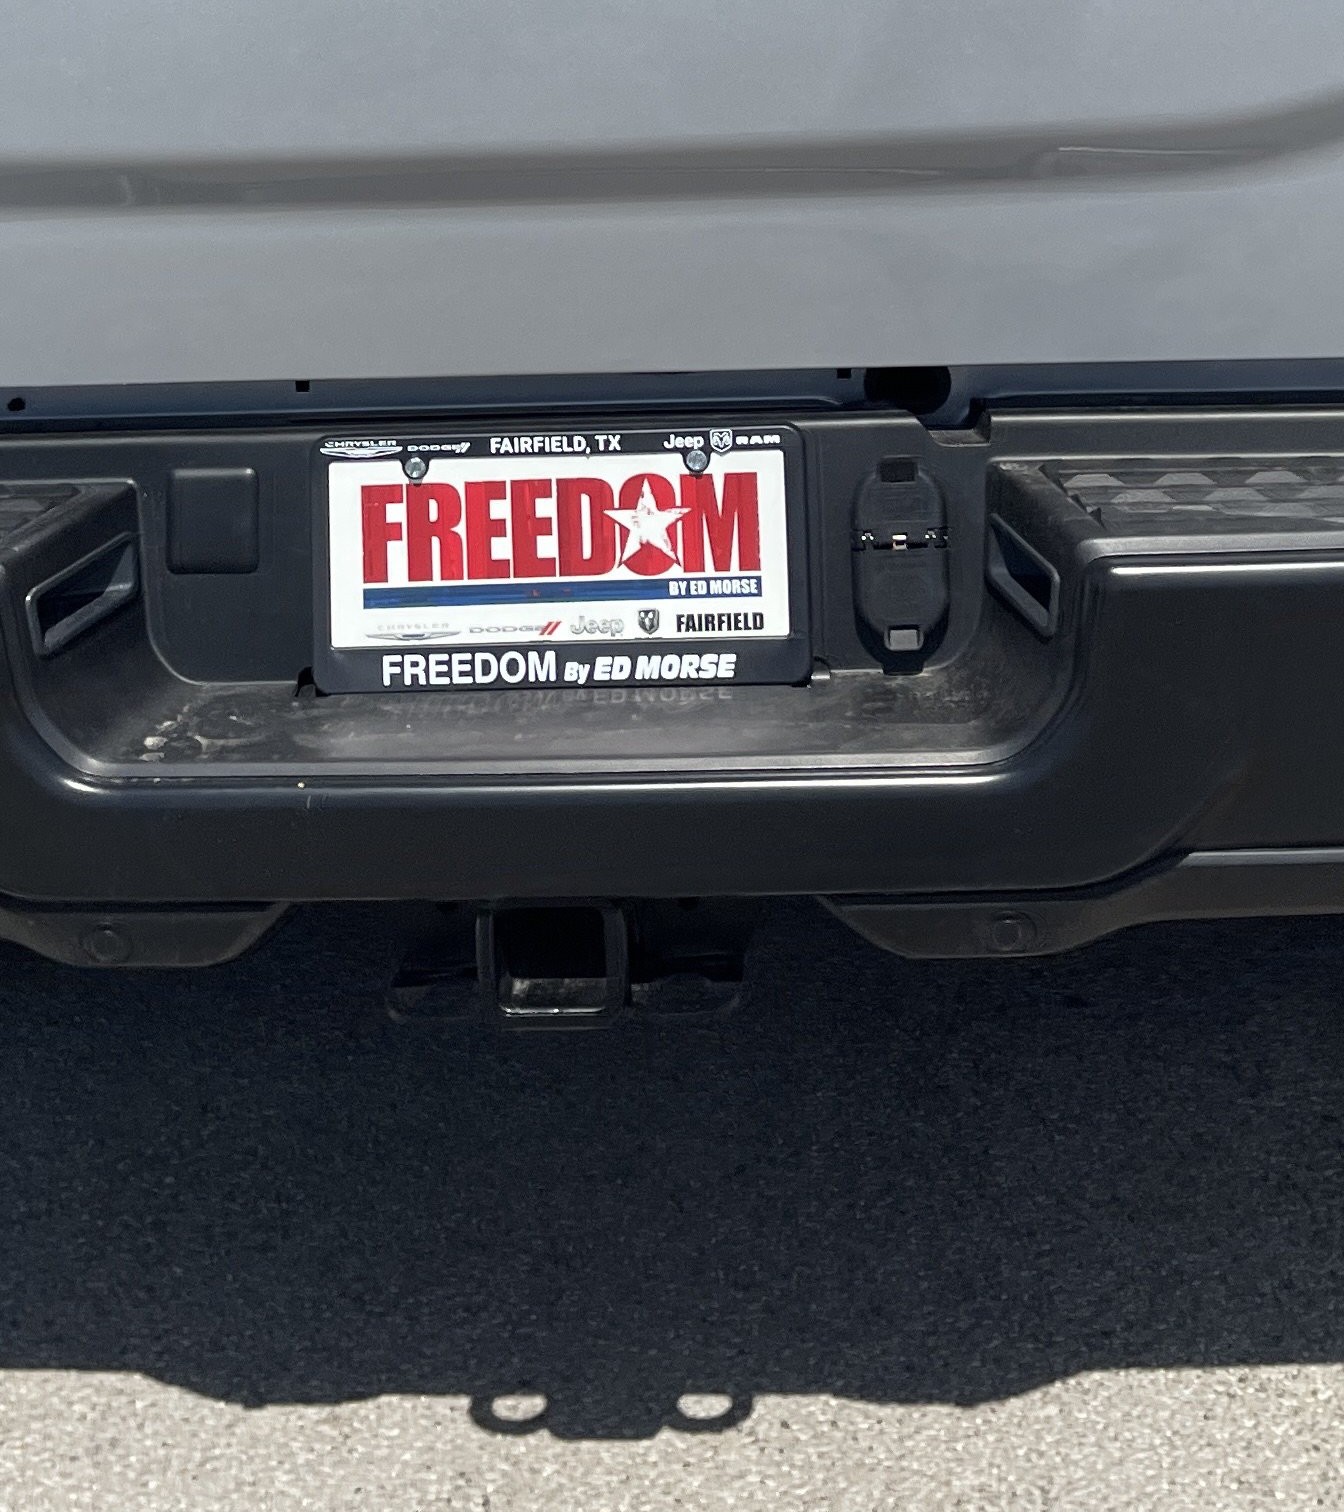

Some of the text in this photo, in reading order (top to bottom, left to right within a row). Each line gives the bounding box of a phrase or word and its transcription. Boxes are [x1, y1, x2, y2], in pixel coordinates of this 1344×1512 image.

[490, 434, 622, 454] FAIRFIELD, TX
[663, 434, 705, 450] Jeep
[735, 434, 781, 445] RAM
[361, 472, 761, 583] FREEDOM
[668, 578, 758, 596] BY ED MORSE
[570, 616, 624, 637] Jeep
[676, 612, 765, 633] FAIRFIELD
[382, 650, 737, 687] FREEDOM By ED MORSE
